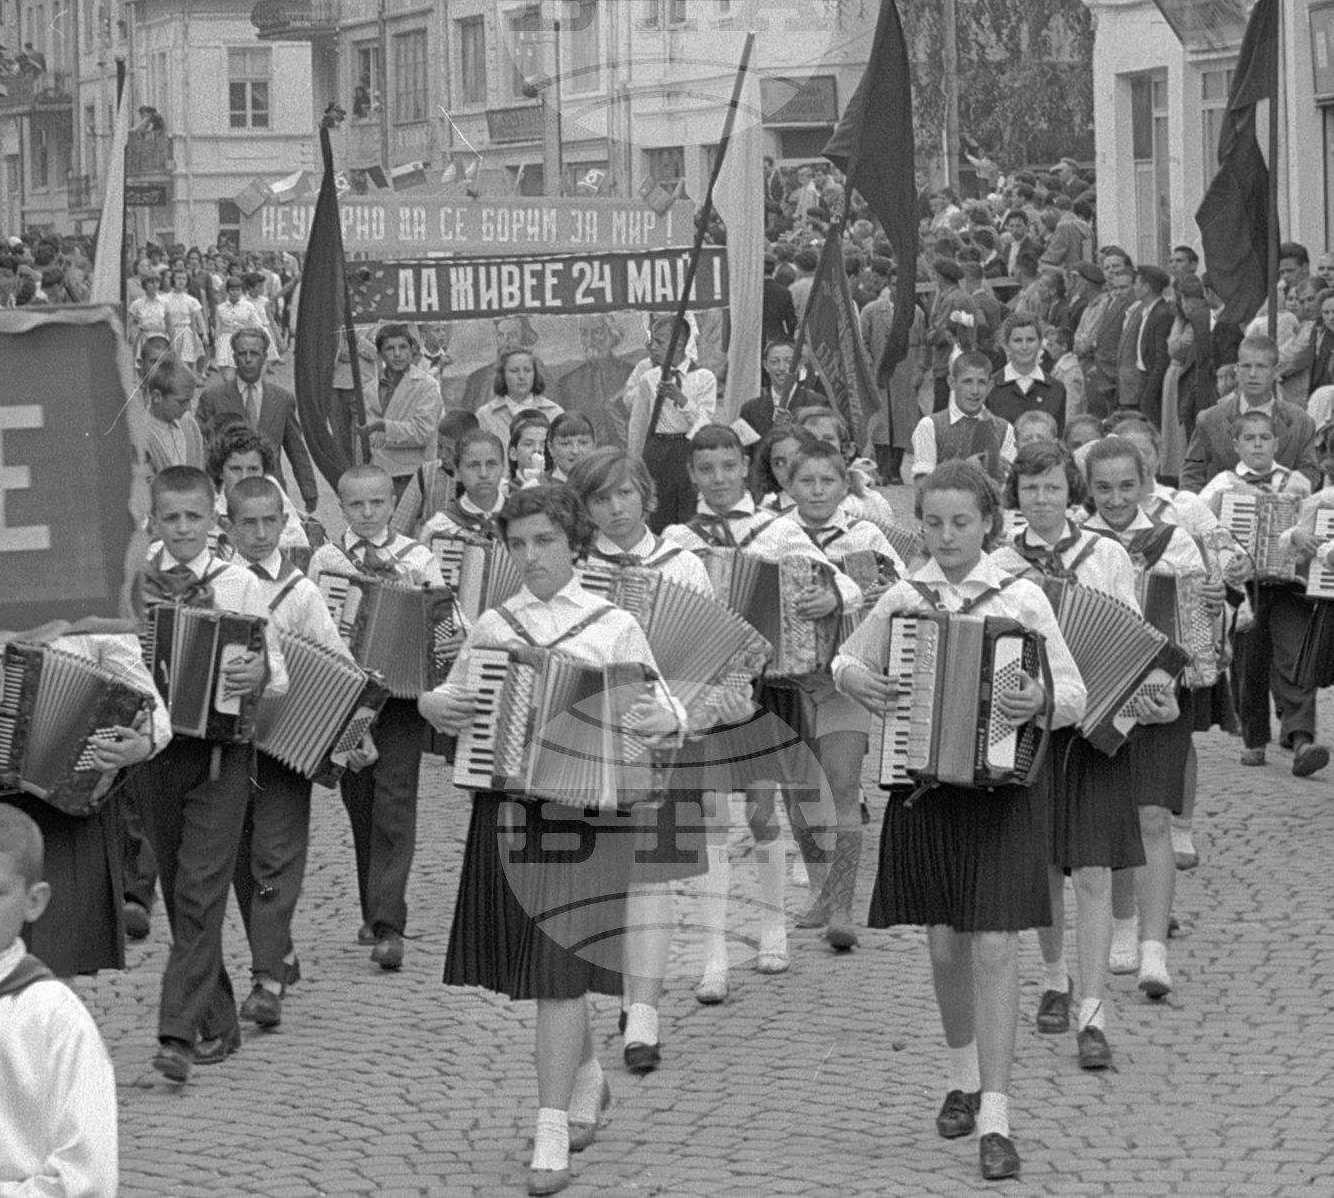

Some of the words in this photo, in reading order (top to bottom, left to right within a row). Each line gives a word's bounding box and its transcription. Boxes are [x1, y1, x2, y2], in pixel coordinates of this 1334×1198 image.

[261, 205, 386, 241] НЕУРНО
[398, 205, 427, 242] ДА
[440, 206, 468, 243] СЕ
[481, 206, 558, 244] БОРИМ
[570, 208, 598, 244] ЗА
[612, 209, 656, 245] МИР
[397, 266, 441, 314] ДА
[449, 261, 563, 313] ЖИВЕЕ
[571, 260, 613, 304] 24
